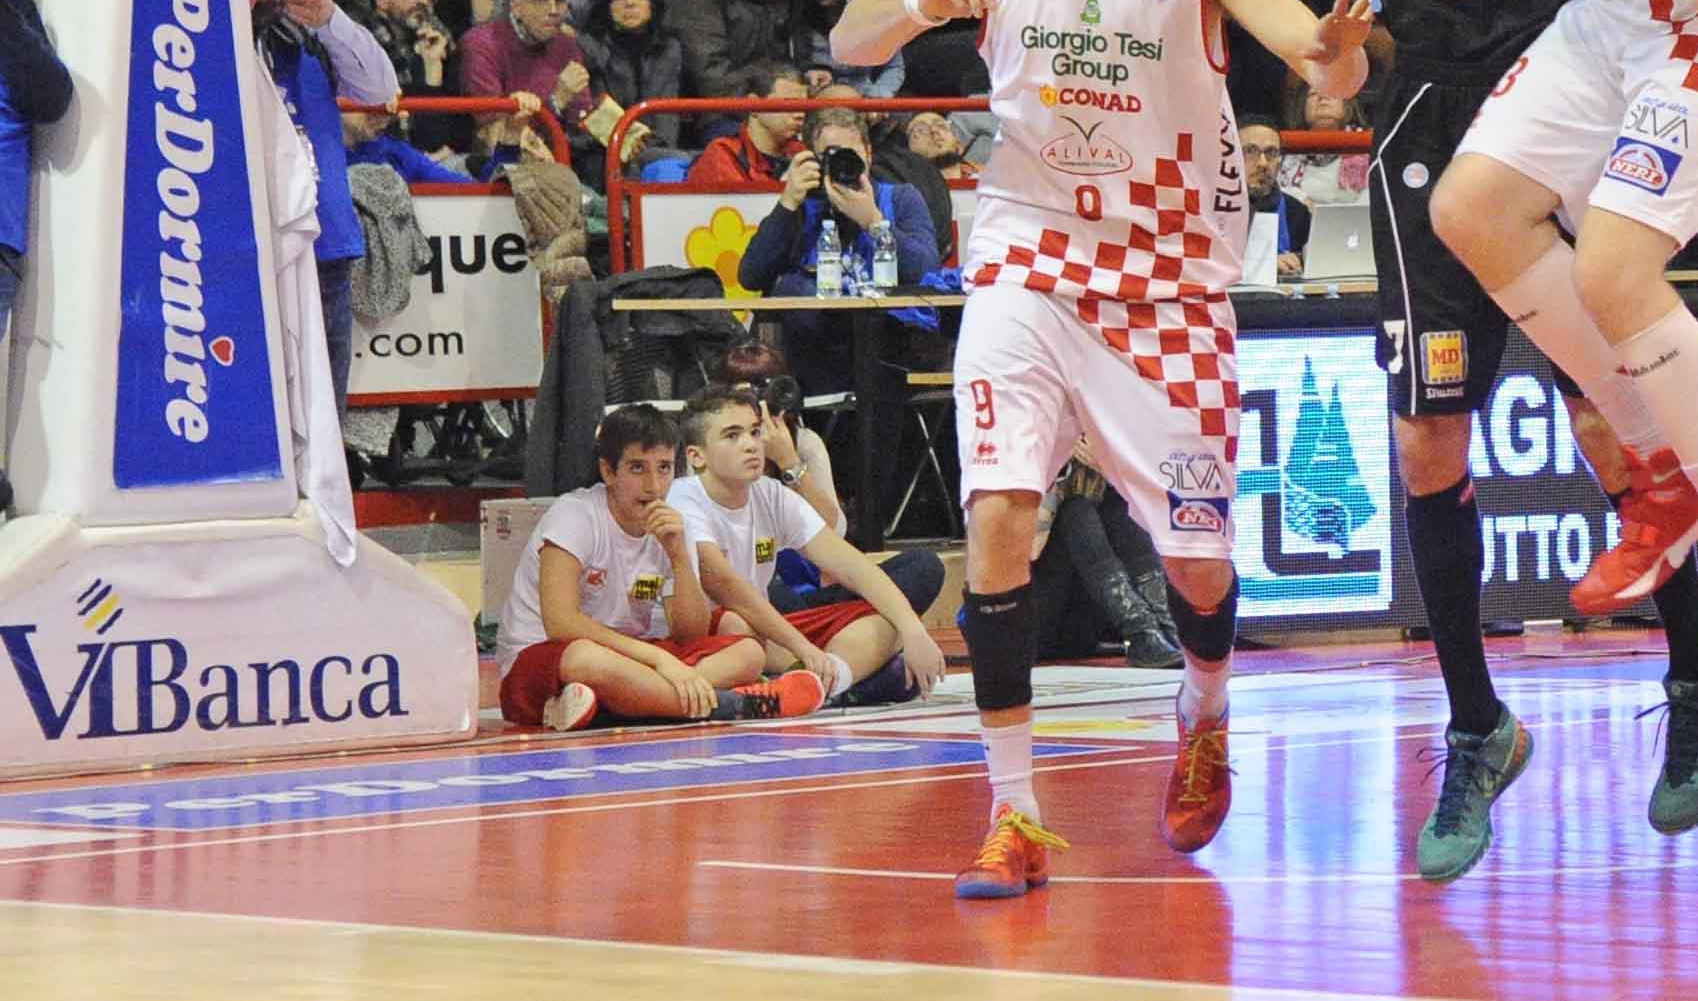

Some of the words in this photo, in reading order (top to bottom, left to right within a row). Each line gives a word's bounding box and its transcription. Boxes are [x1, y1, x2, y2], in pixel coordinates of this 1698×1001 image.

[1021, 25, 1109, 61] Giorgio
[1114, 32, 1164, 62] Tesi
[1051, 53, 1130, 87] Group
[1059, 88, 1142, 114] CONAD
[1047, 146, 1126, 165] ALIVAL
[1383, 320, 1406, 375] 7
[1431, 348, 1460, 367] MD
[1159, 460, 1224, 491] SILVA
